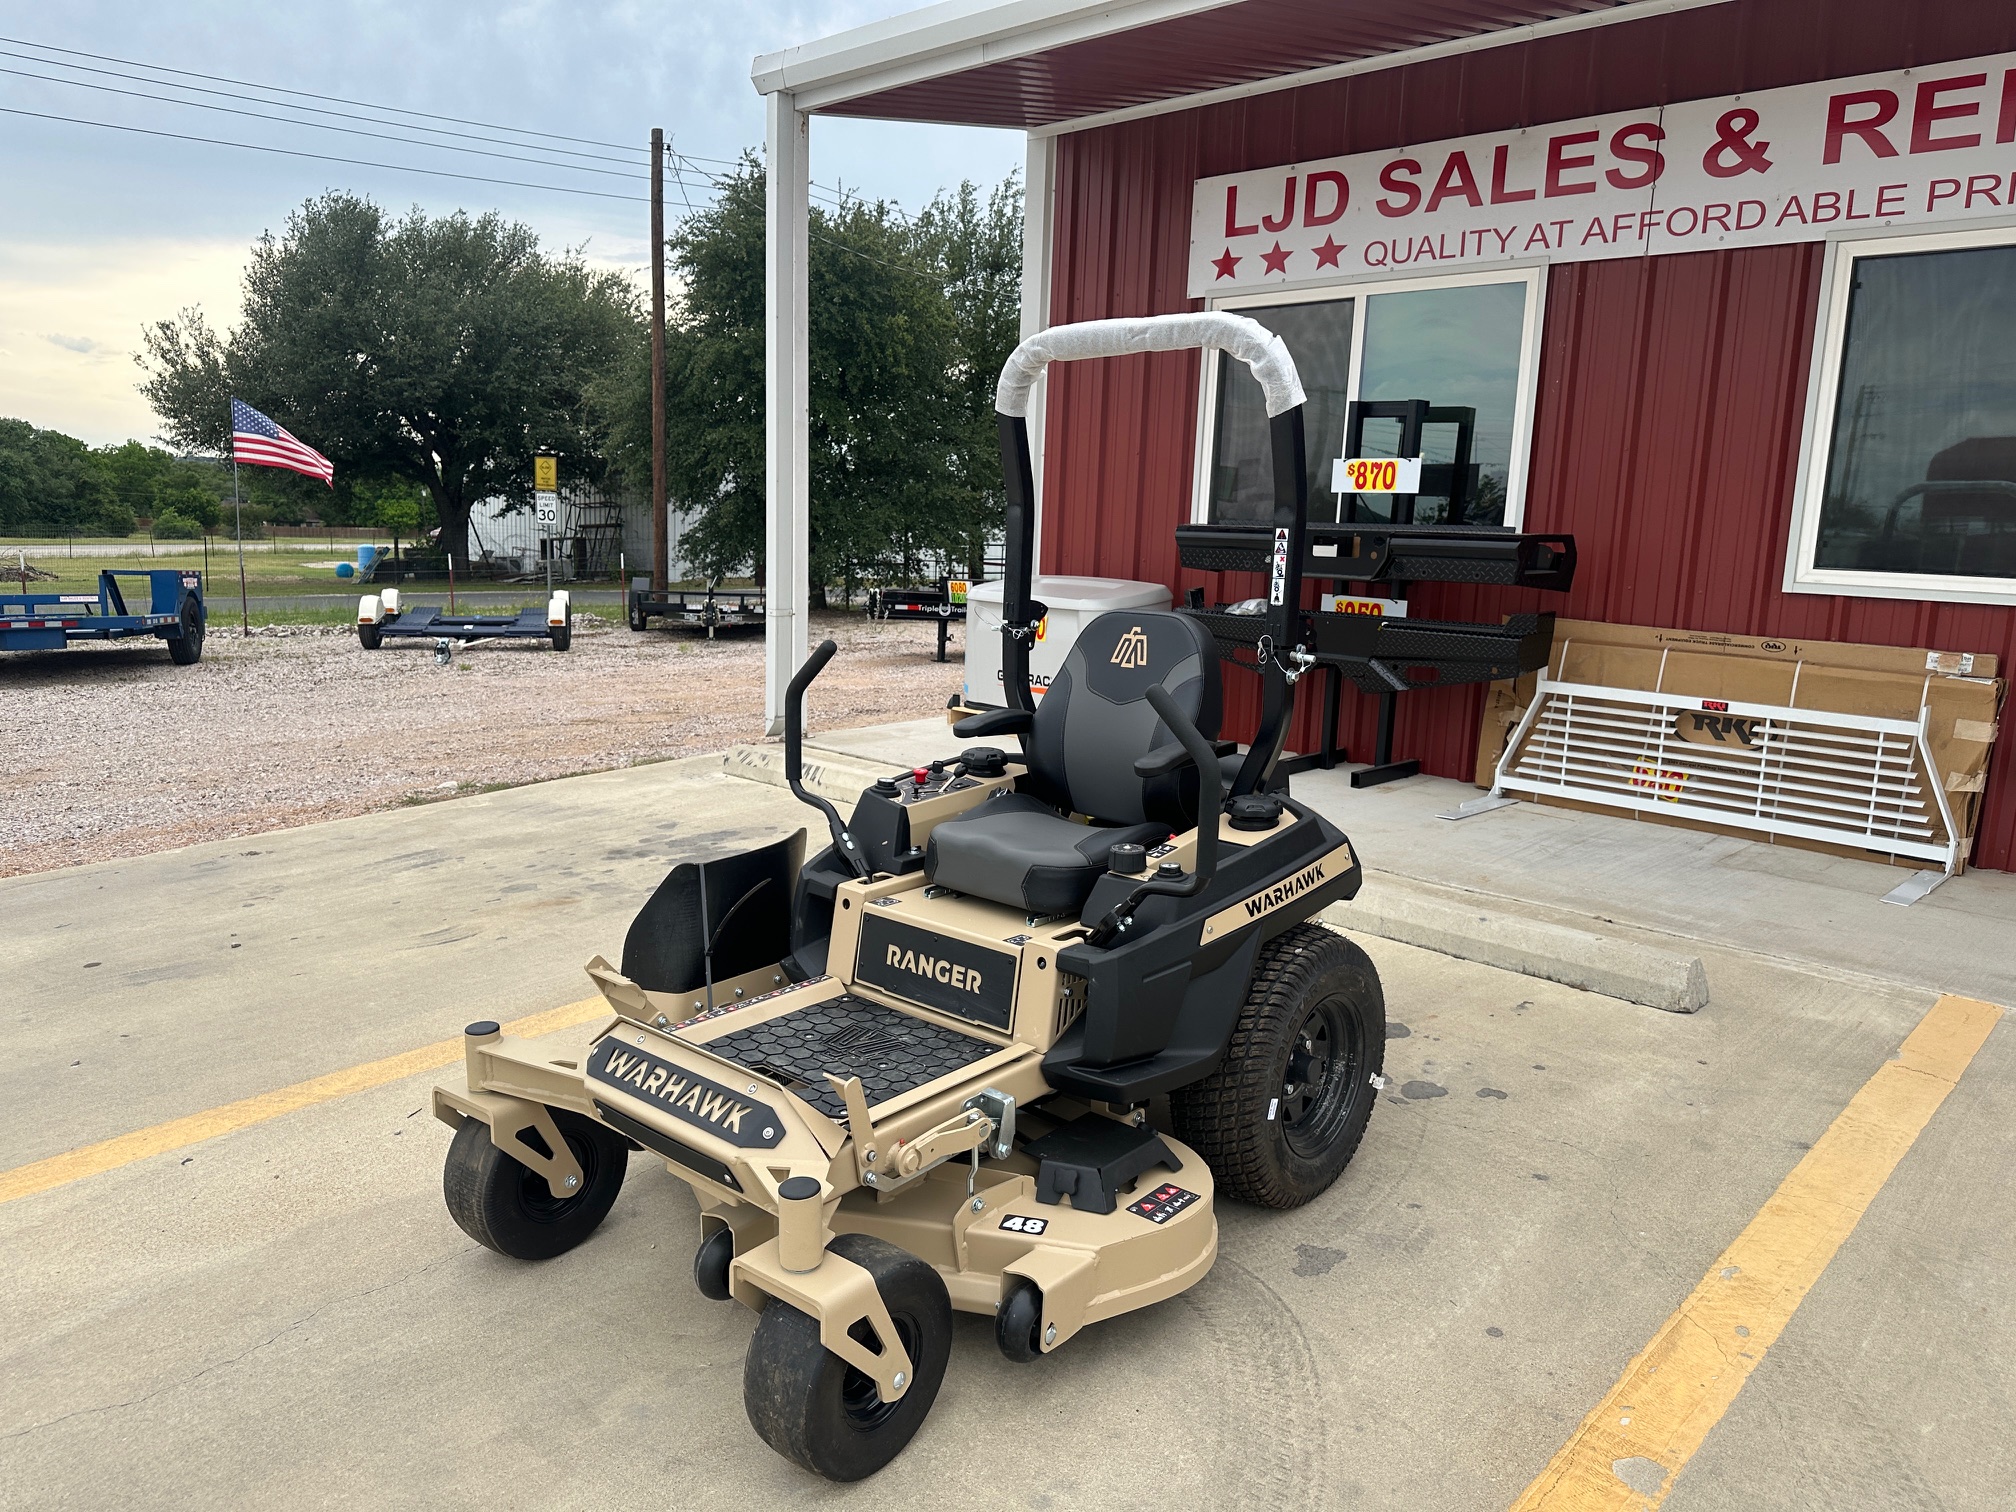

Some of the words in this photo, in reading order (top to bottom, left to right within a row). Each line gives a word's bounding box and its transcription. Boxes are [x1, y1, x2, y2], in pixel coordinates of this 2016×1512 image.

[1224, 170, 1350, 239] LJD
[1376, 123, 1667, 219] SALES
[1702, 107, 1774, 178] &
[1822, 68, 2016, 166] RE
[1363, 227, 1516, 268] QUALITY
[1524, 220, 1573, 251] AT
[1347, 461, 1396, 490] $870
[538, 509, 556, 522] 30
[917, 604, 939, 613] Triple
[997, 669, 1051, 687] GRAC
[1703, 701, 1726, 712] RKI
[1690, 713, 1762, 745] RKI
[1244, 863, 1325, 918] WARHAWK
[886, 943, 983, 995] RANGER
[604, 1046, 754, 1135] WARHAWK
[1002, 1216, 1045, 1234] 48
